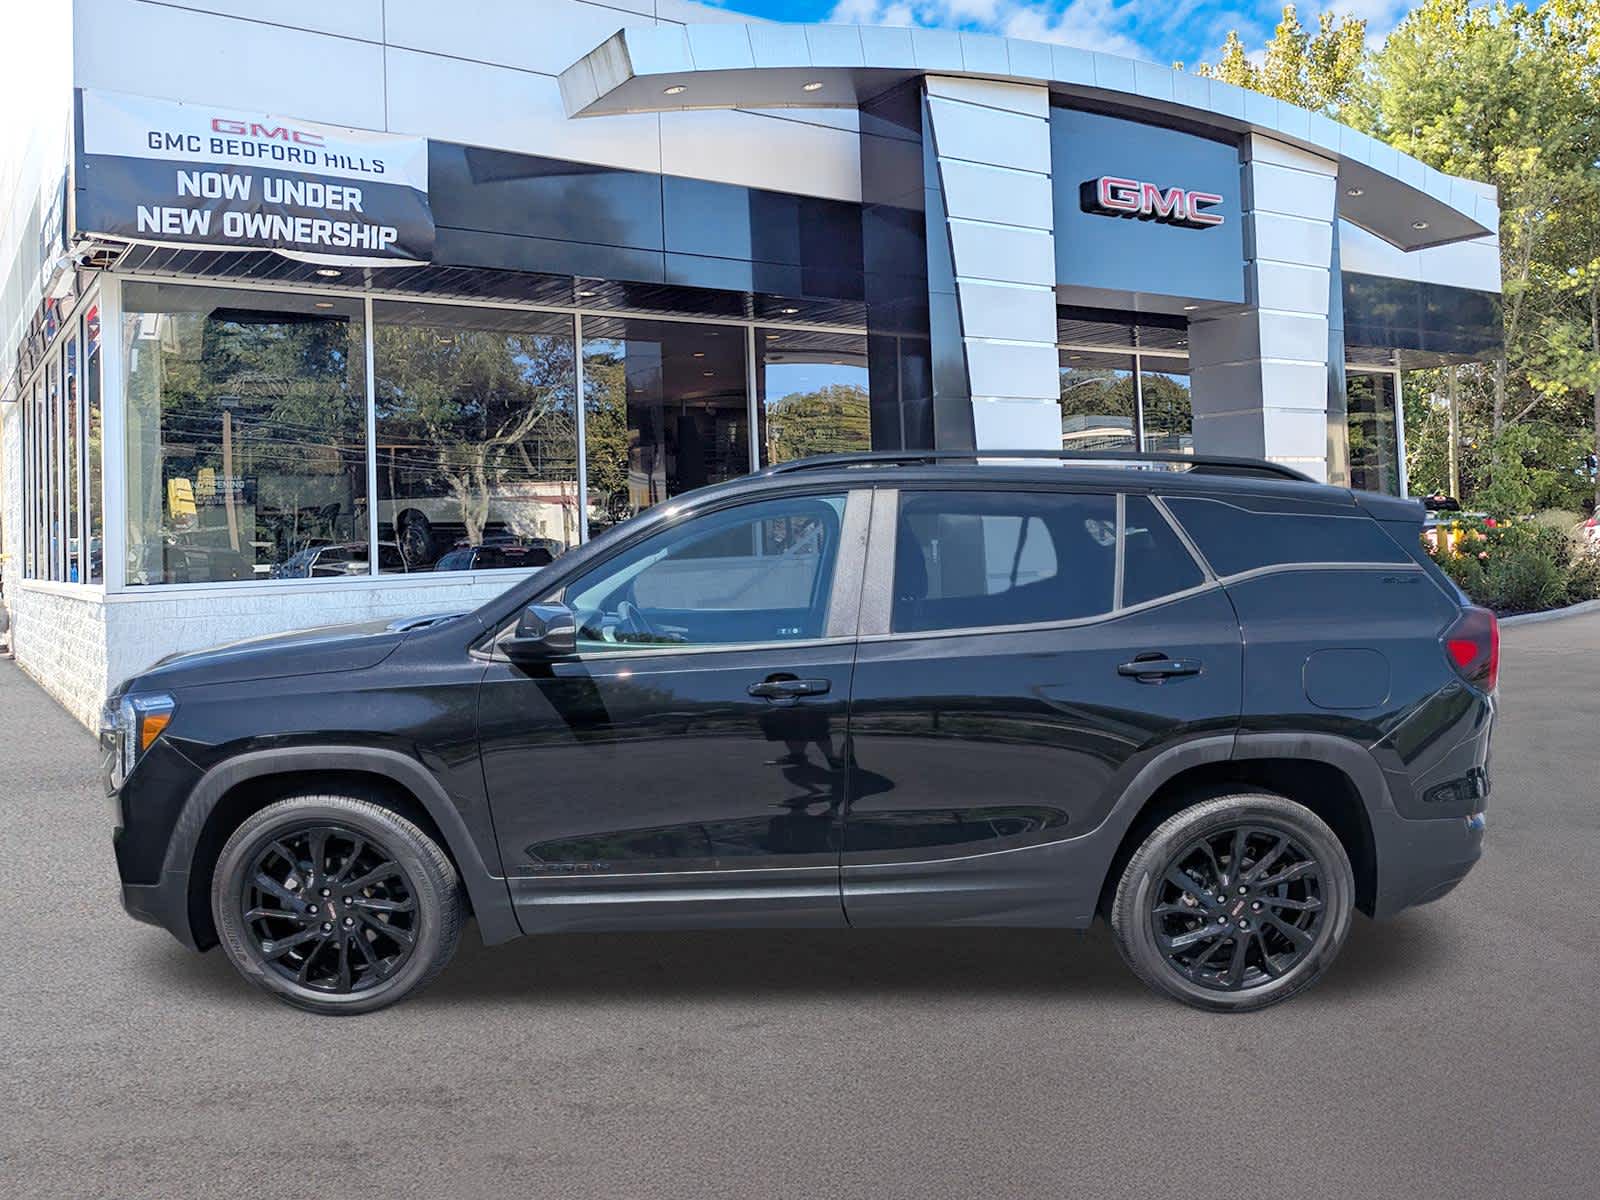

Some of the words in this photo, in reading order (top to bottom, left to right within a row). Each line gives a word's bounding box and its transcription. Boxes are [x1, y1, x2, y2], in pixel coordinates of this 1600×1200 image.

[148, 131, 201, 152] GMC
[210, 138, 317, 166] BEDFORD
[324, 153, 385, 174] HILLS
[211, 117, 325, 148] GMC
[177, 170, 252, 201] NOW
[263, 177, 364, 213] UNDER
[1096, 175, 1225, 225] GMC
[136, 206, 212, 236] NEW
[223, 212, 398, 251] OWNERSHIP
